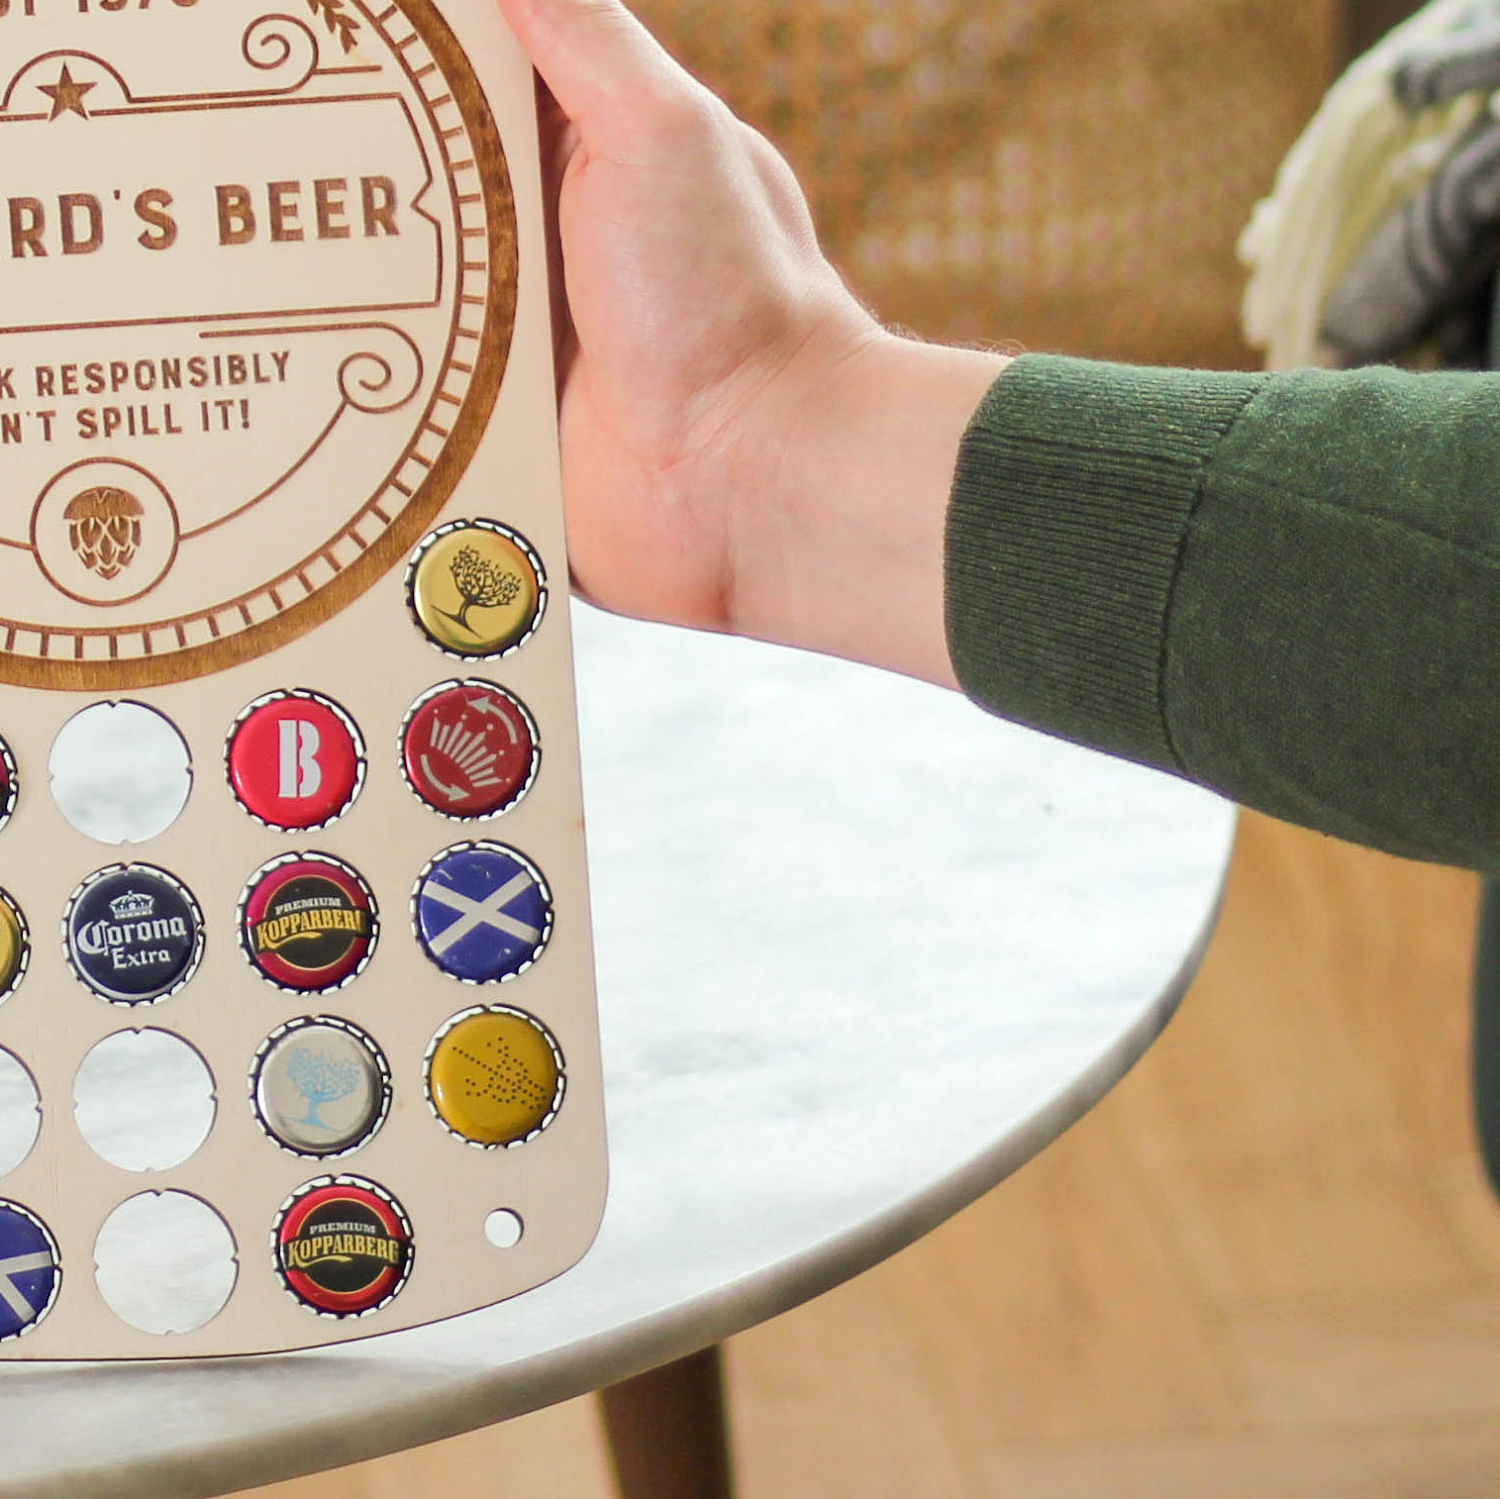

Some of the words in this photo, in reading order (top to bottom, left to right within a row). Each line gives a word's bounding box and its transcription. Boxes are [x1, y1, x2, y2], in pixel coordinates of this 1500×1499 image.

[215, 174, 401, 247] BEER
[35, 350, 292, 399] RESPONSIBLY
[76, 404, 183, 440] SPILL
[202, 399, 252, 433] IT!
[278, 719, 322, 798] B
[275, 897, 341, 915] PREMIUM
[77, 916, 187, 956] Corona
[113, 947, 171, 970] Extra
[310, 1222, 376, 1235] PREMIUM
